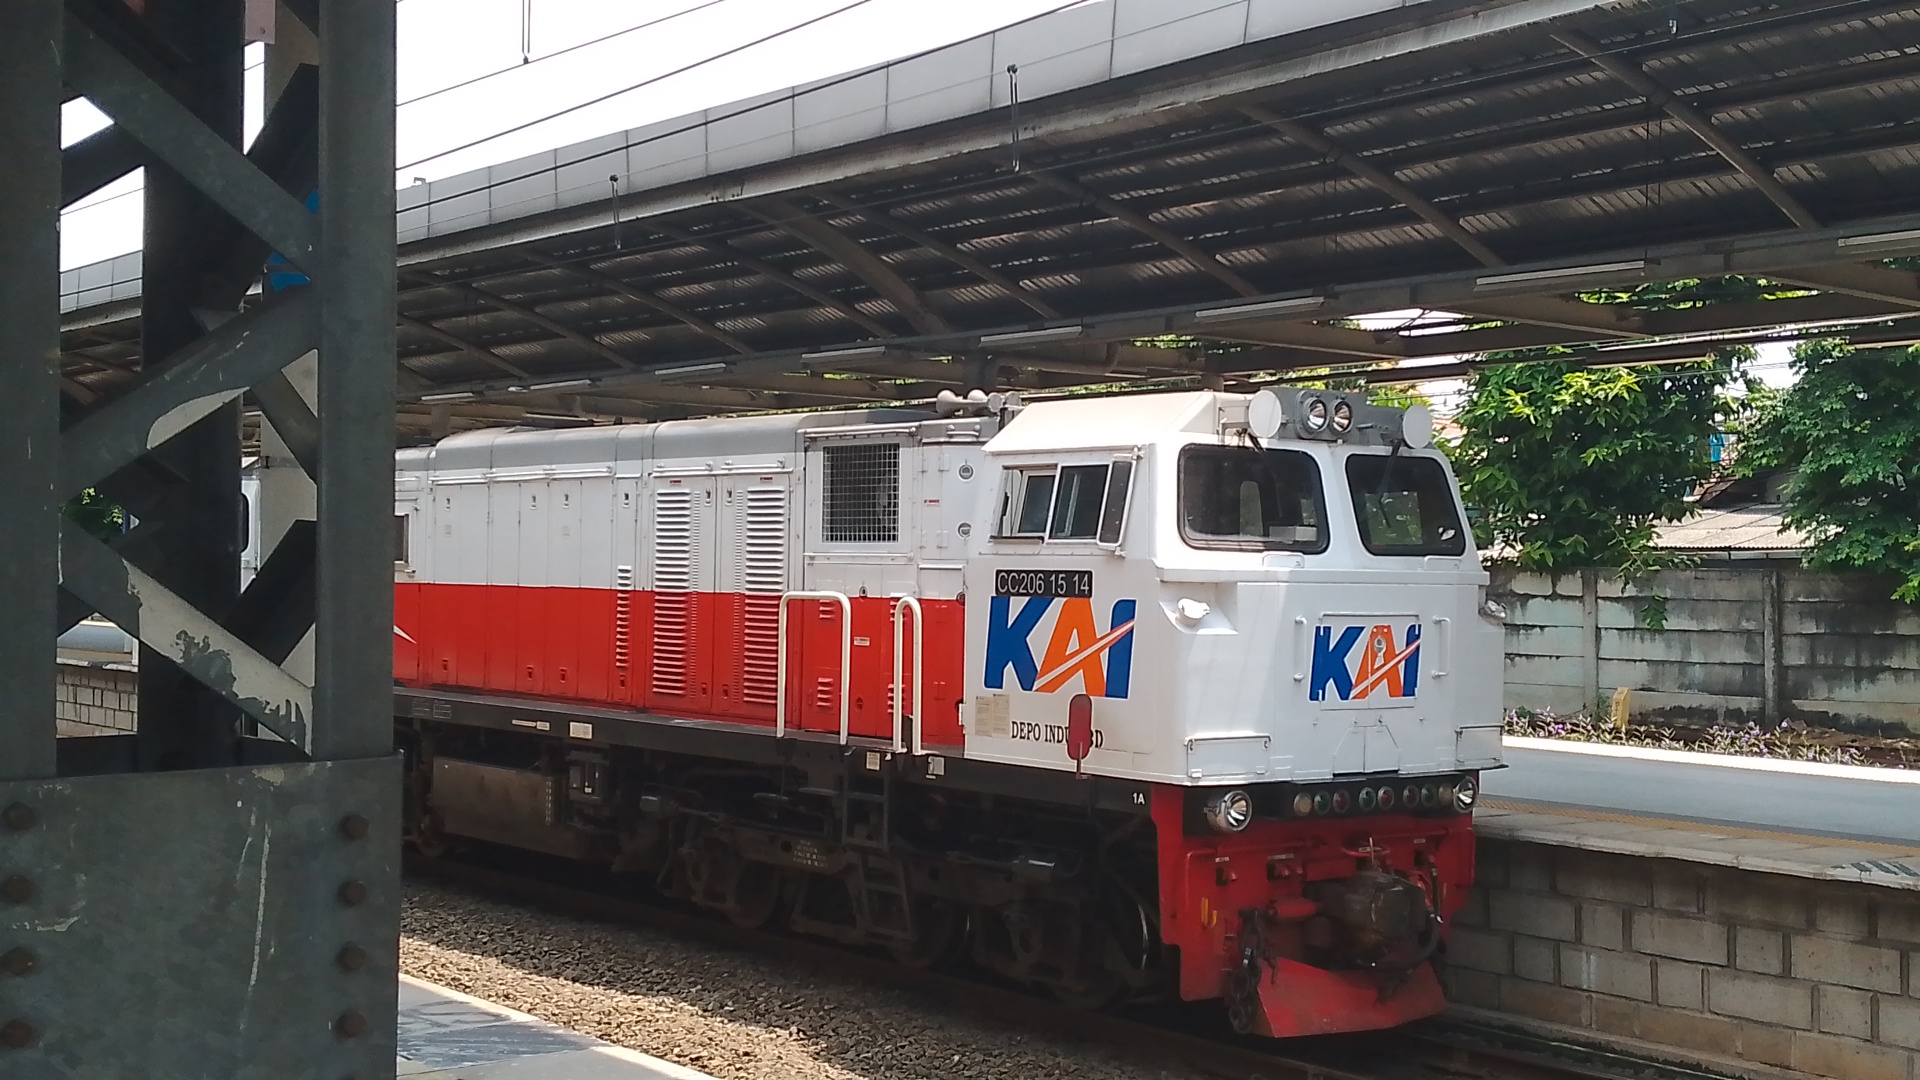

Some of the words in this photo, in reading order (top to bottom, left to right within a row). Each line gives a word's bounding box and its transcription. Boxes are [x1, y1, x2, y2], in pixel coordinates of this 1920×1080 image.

[997, 572, 1045, 594] CC206
[1049, 573, 1067, 595] 15
[1073, 573, 1090, 595] 14
[984, 596, 1135, 699] KAI
[1309, 623, 1422, 701] KAI
[1011, 721, 1041, 741] DEPO
[1132, 792, 1146, 805] 1A
